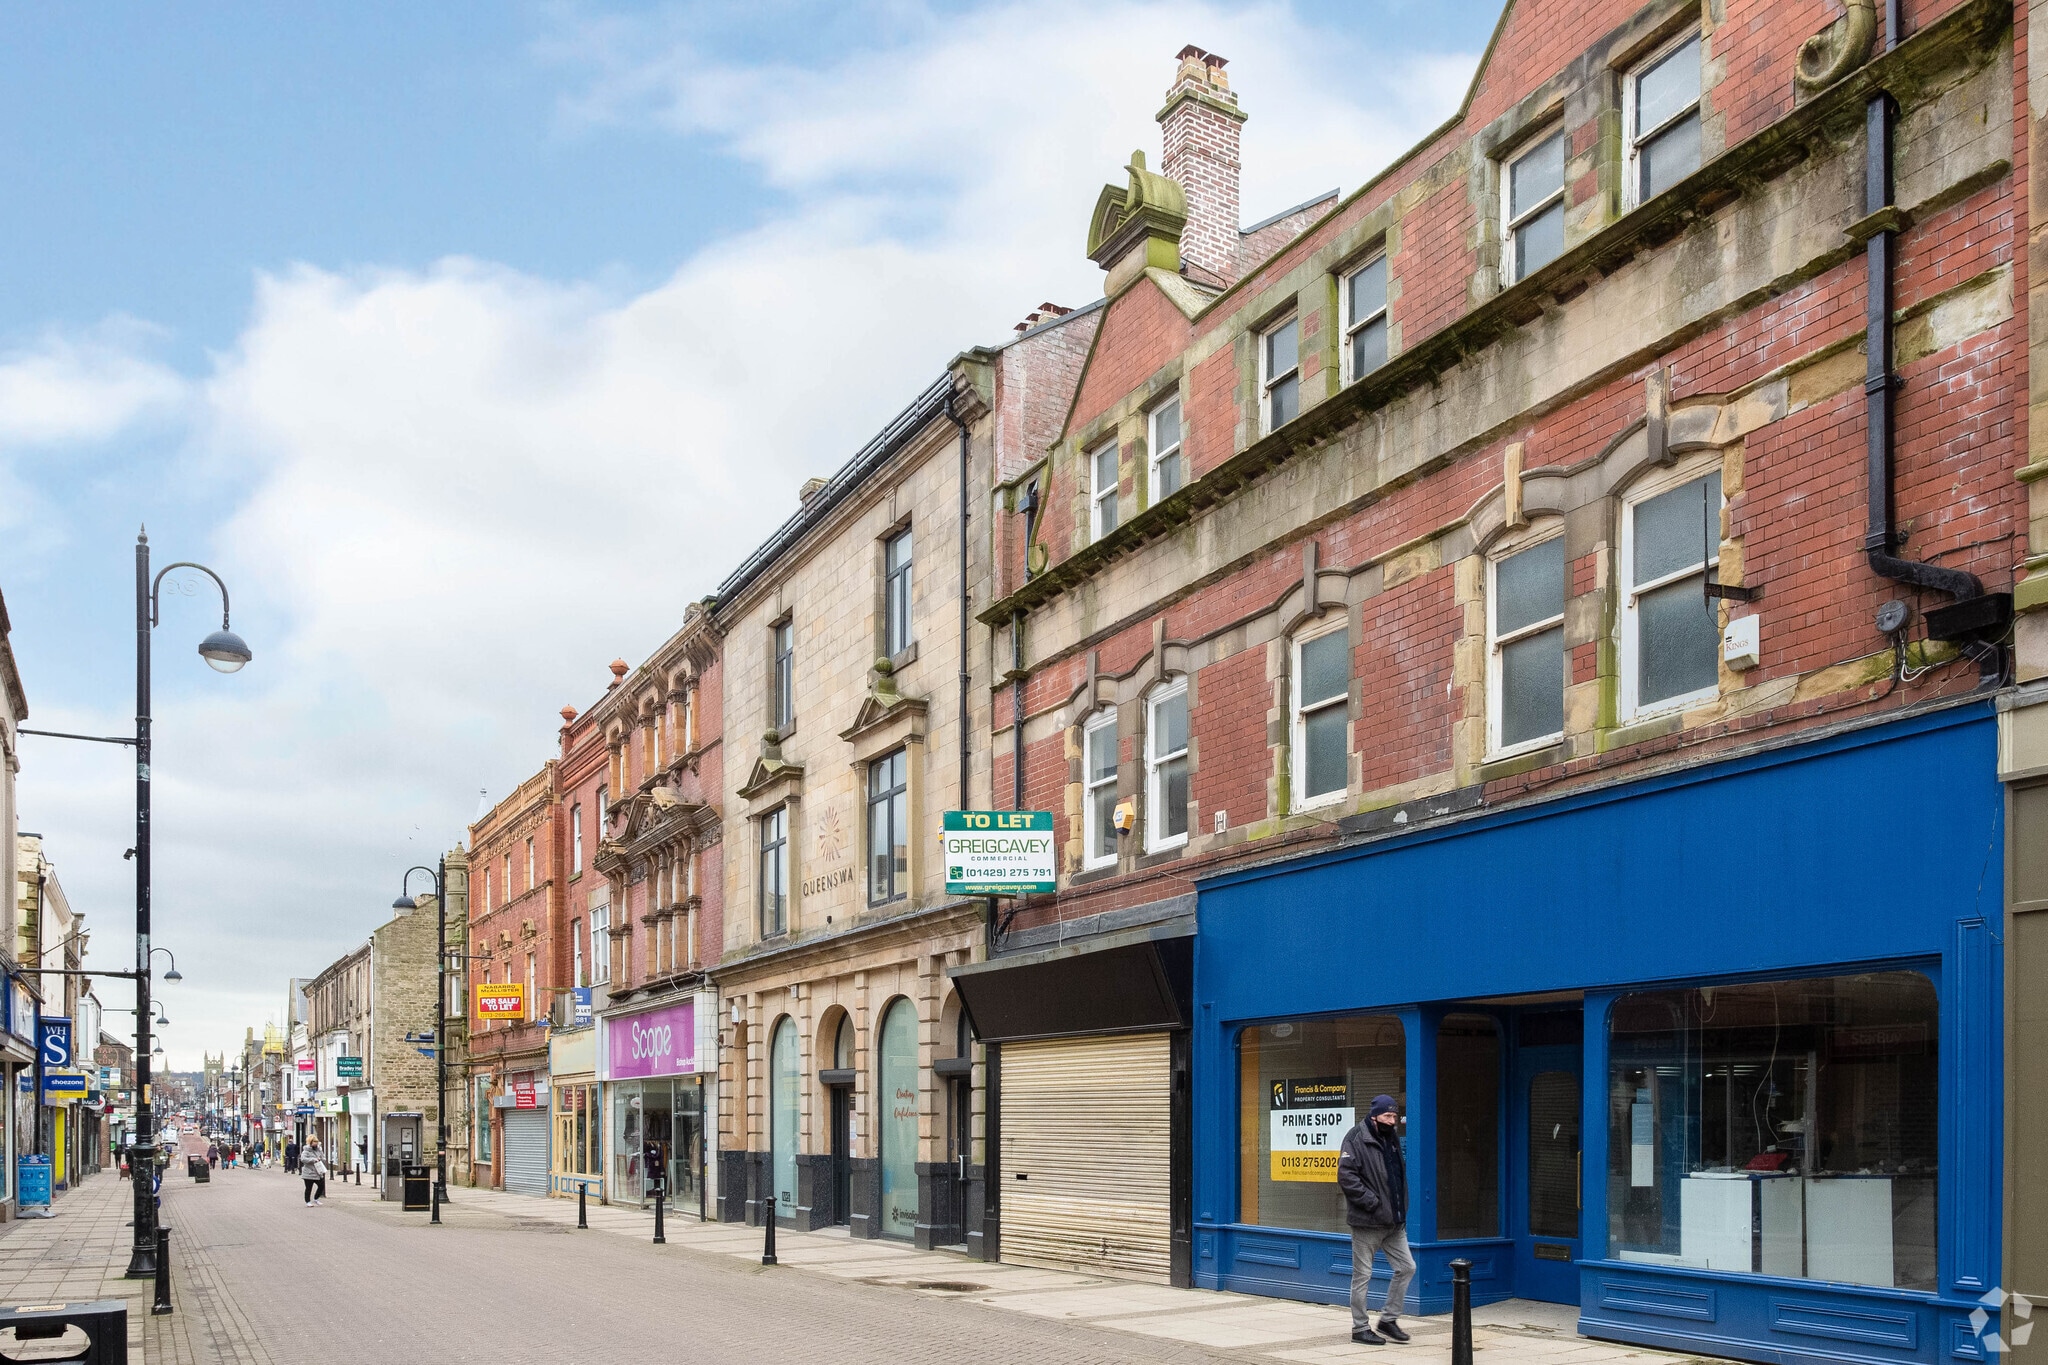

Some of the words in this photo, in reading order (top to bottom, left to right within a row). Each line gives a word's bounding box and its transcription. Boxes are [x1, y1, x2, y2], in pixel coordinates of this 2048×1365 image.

[963, 814, 991, 828] TO
[997, 814, 1035, 828] LET
[948, 839, 1050, 853] GREIGCAVEY
[966, 868, 1006, 877] (01429)
[1009, 869, 1029, 877] 275
[1032, 868, 1051, 876] 791
[803, 865, 855, 897] QUEENSWA
[45, 1026, 66, 1035] WH
[44, 1035, 67, 1065] S
[632, 1021, 672, 1069] Scope
[1295, 1085, 1314, 1094] Francis
[1314, 1084, 1319, 1093] &
[1319, 1084, 1347, 1094] Company
[1316, 1094, 1346, 1102] CONSULTANTS
[1282, 1114, 1313, 1127] PRIME
[1315, 1113, 1342, 1126] SHOP
[1296, 1133, 1308, 1145] TO
[1311, 1133, 1327, 1145] LET
[1282, 1156, 1301, 1168] 0113
